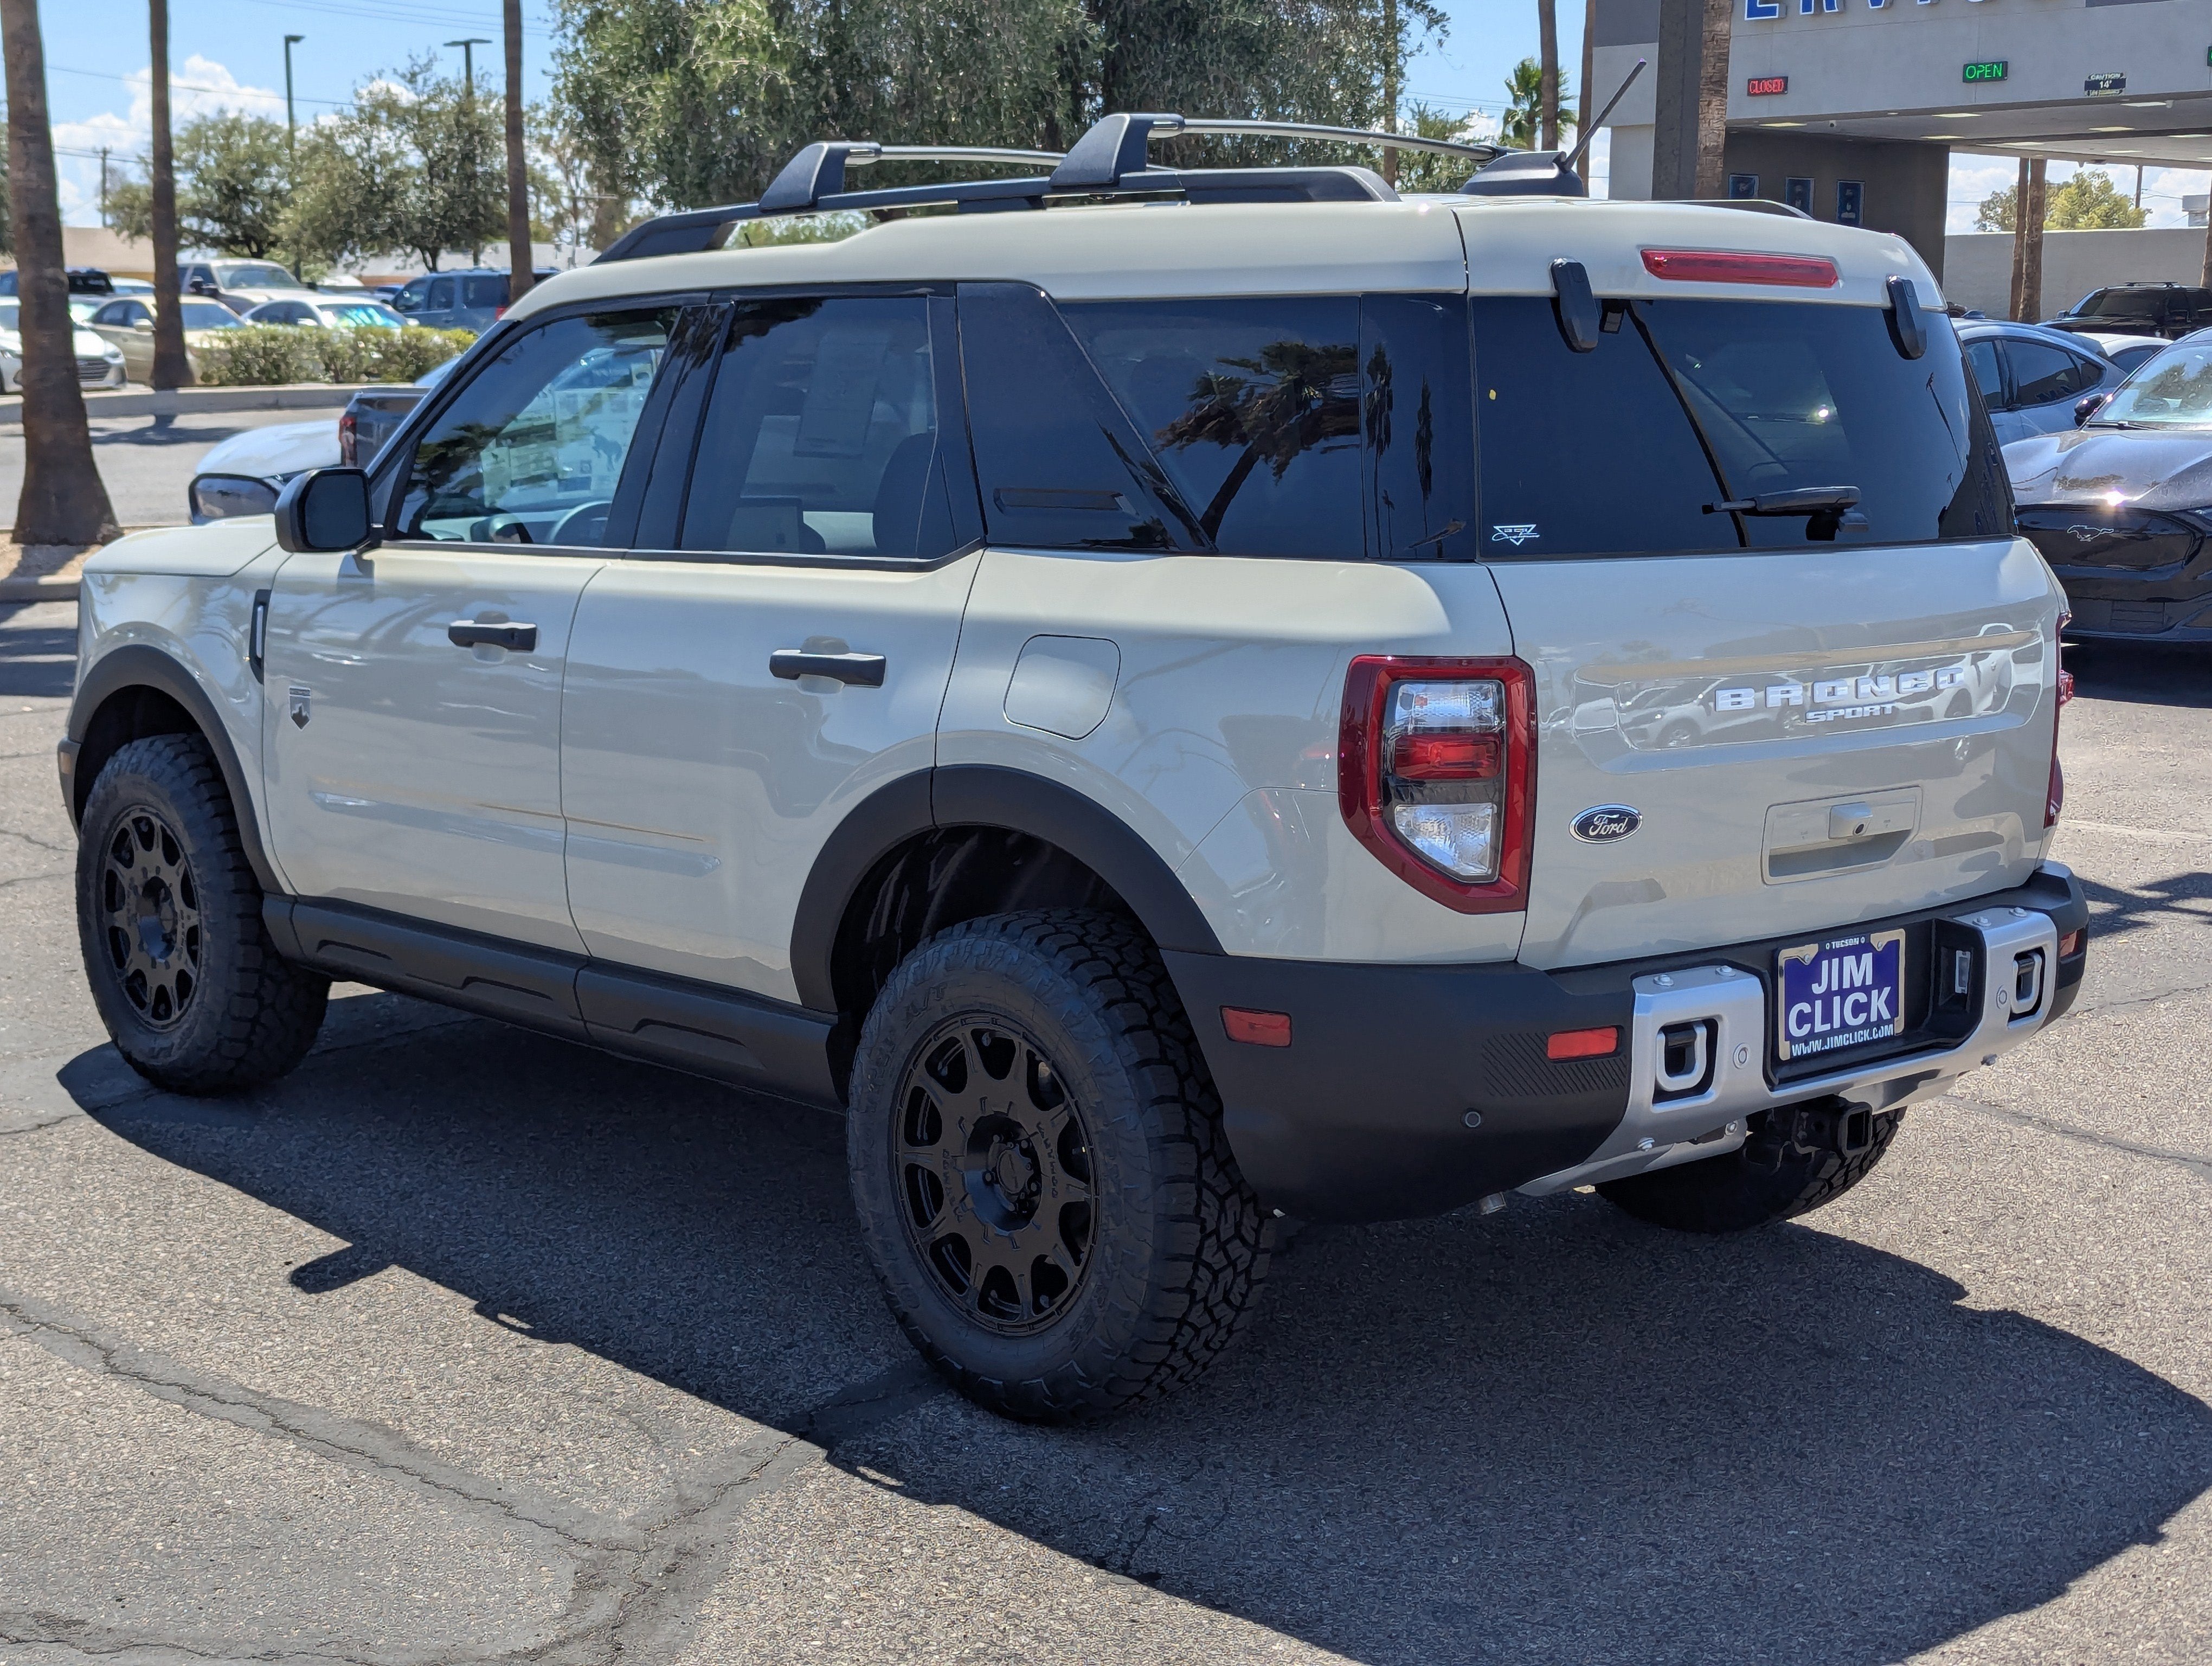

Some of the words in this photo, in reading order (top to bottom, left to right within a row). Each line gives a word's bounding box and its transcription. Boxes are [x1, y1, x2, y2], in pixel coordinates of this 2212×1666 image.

[1965, 62, 2003, 79] OPEN
[1750, 79, 1784, 94] CLOSED
[1715, 667, 1965, 712] BRONCO
[1805, 704, 1894, 723] SPORT
[1589, 813, 1629, 836] Ford
[1811, 952, 1873, 995] JIM
[1789, 986, 1892, 1037] CLICK
[1792, 1023, 1894, 1057] WWW.JIMCLICK.COM
